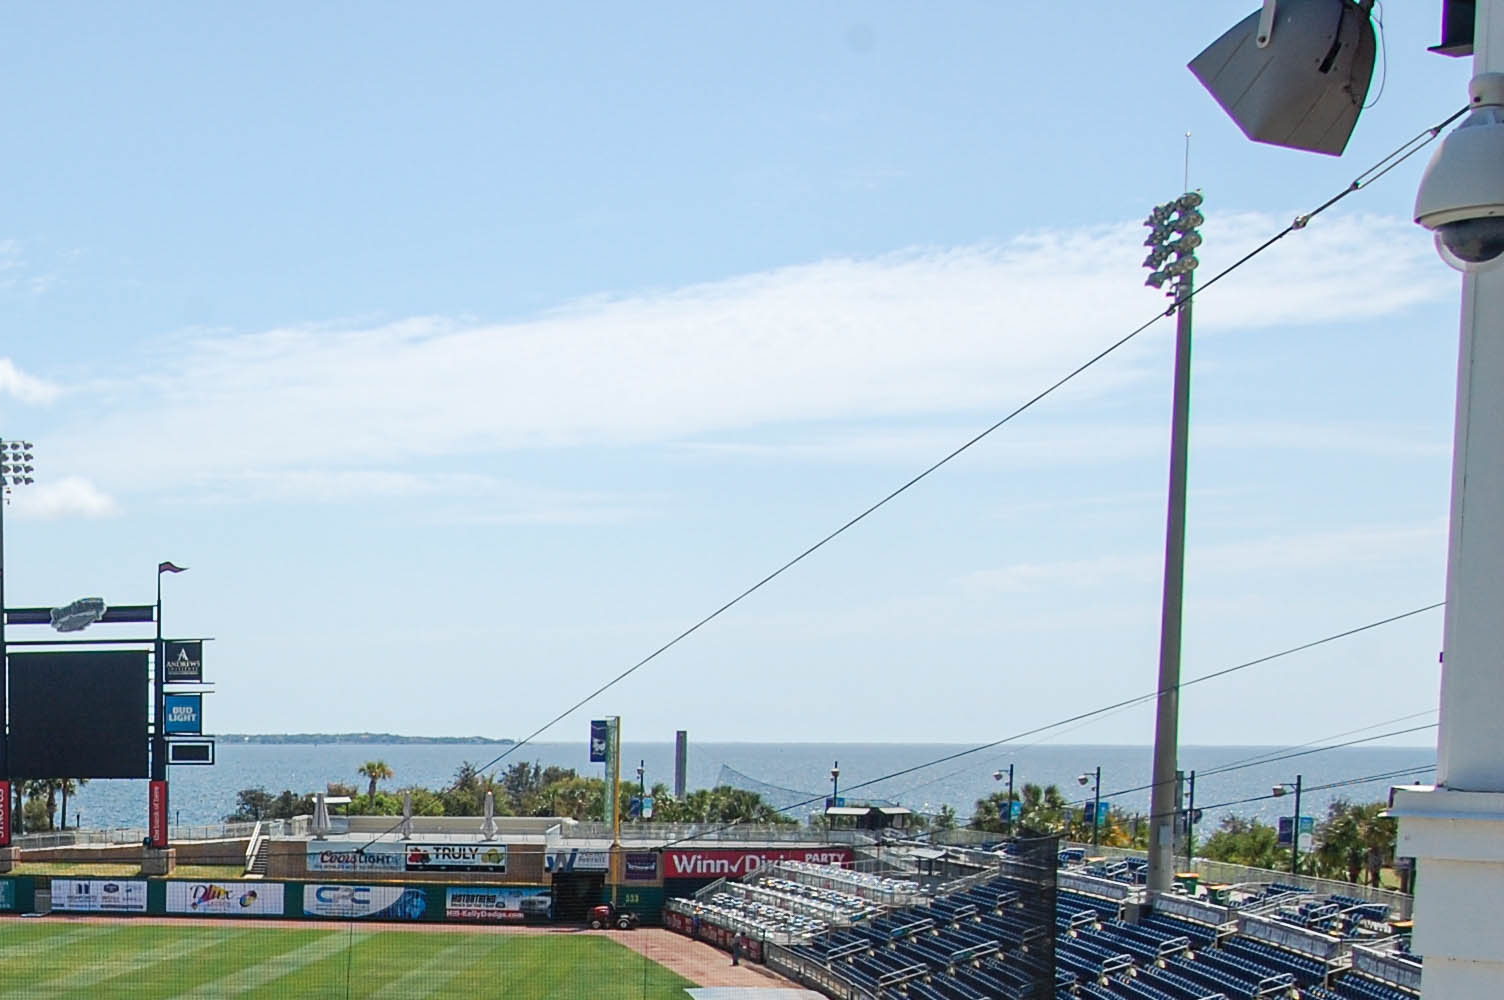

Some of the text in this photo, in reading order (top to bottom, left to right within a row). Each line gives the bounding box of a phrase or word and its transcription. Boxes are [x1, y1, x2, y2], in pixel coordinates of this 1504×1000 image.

[172, 706, 193, 715] BUD
[168, 714, 198, 723] LIGHT
[320, 850, 392, 865] Coors LIGHT
[433, 847, 479, 860] TRULY
[805, 852, 846, 863] PARTY
[672, 853, 728, 873] Winn
